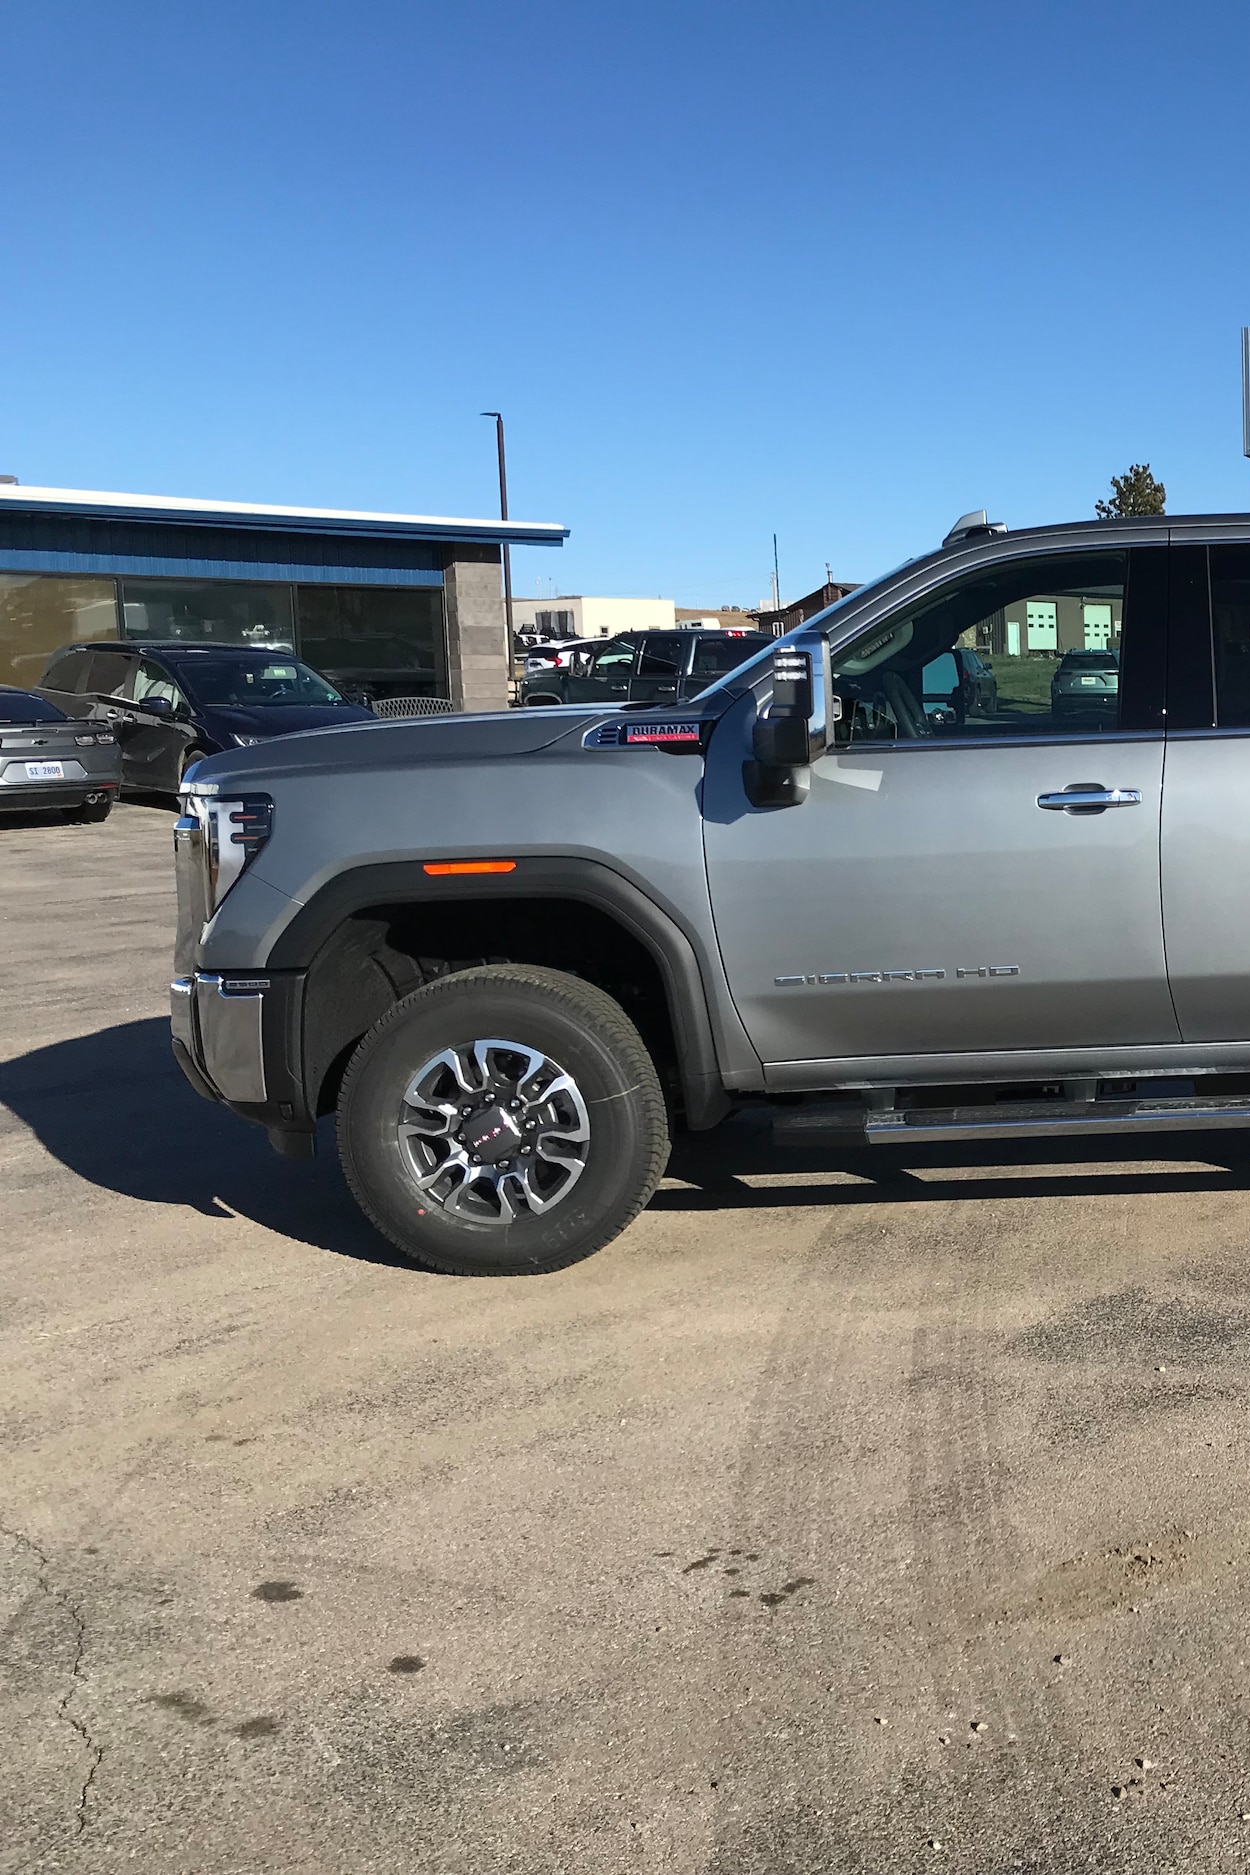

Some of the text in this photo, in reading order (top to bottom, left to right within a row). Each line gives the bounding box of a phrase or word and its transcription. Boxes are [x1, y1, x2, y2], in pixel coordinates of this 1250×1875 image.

[632, 725, 695, 736] DURAMAX
[774, 965, 1020, 987] SIERRA HD
